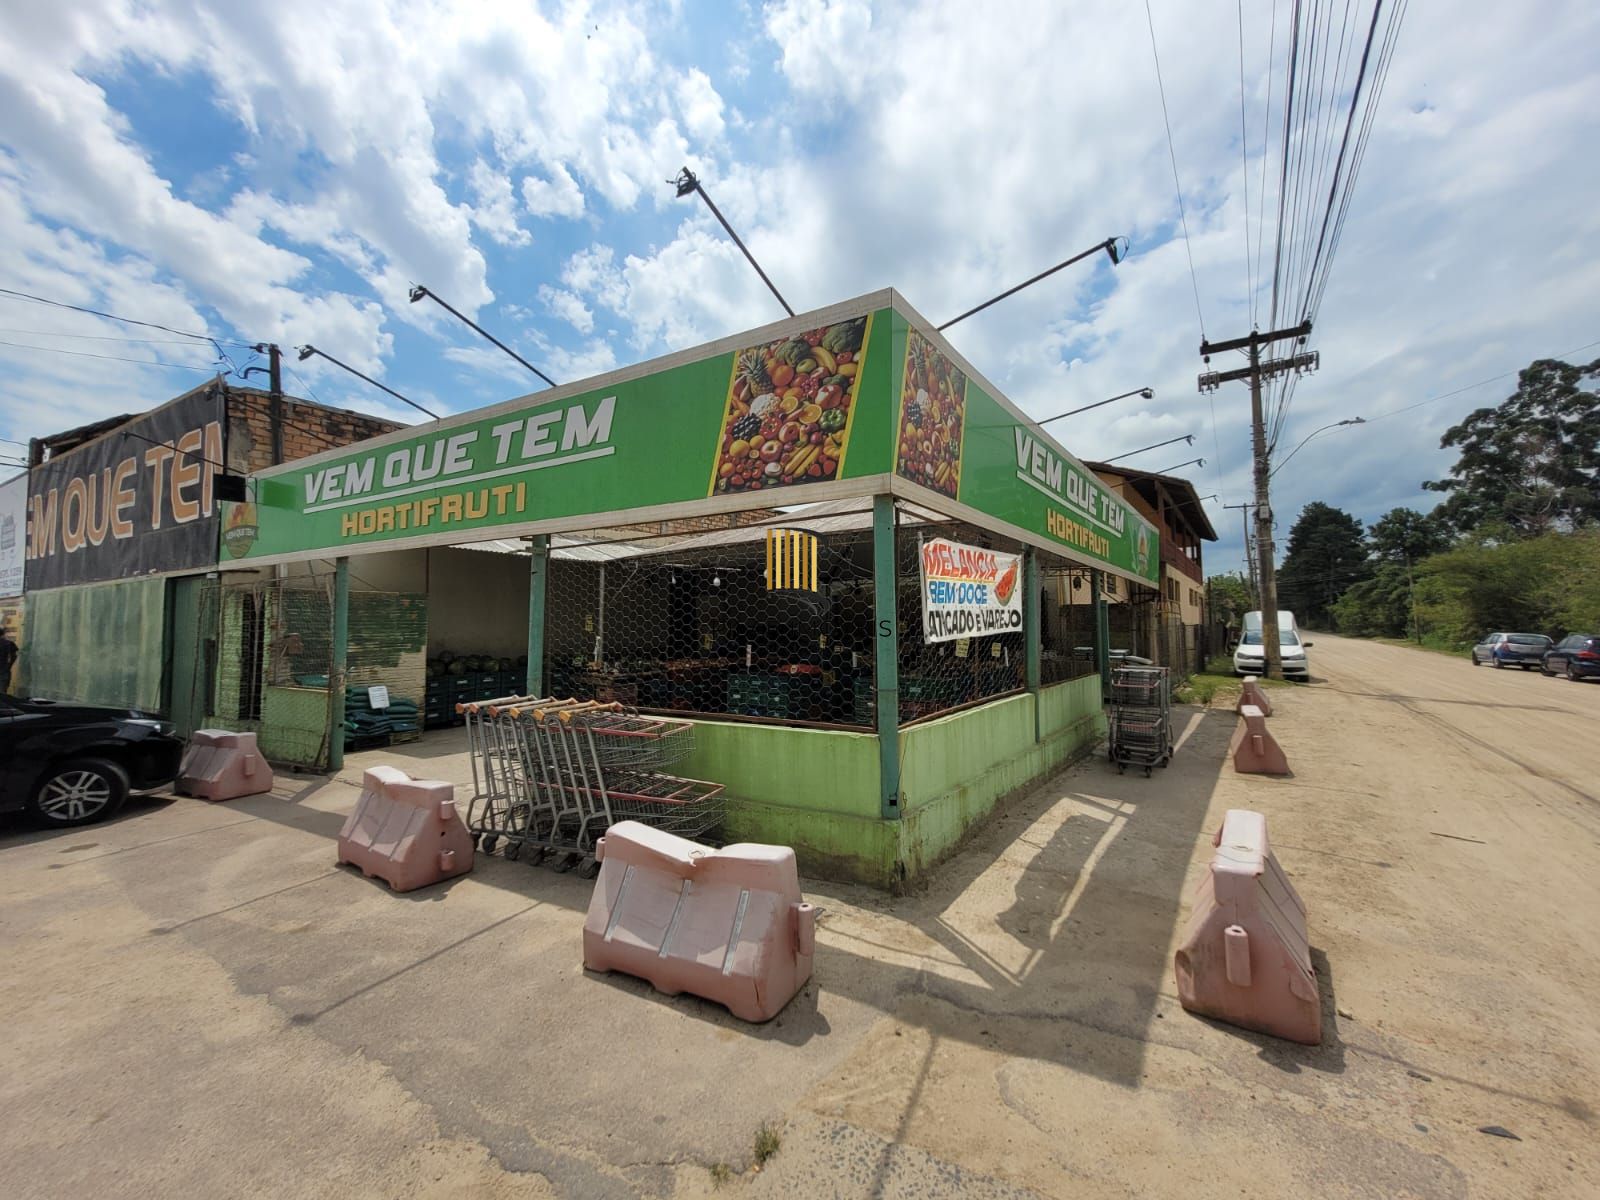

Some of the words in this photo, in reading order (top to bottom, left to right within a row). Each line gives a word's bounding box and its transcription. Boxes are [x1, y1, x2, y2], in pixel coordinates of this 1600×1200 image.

[304, 457, 376, 504] VEM
[382, 430, 478, 488] QUE
[492, 396, 616, 465] TEM
[62, 456, 137, 553] QUE
[1014, 425, 1062, 492] VEM
[1066, 469, 1098, 516] QUE
[1101, 494, 1125, 533] TEM
[341, 481, 526, 537] HORTIFRUTI
[1047, 507, 1109, 558] HORTIFRUTI
[923, 543, 998, 580] MELANCIA
[929, 581, 956, 604] BEM
[958, 582, 988, 604] DOCE
[975, 613, 981, 632] E
[980, 609, 1021, 631] VAREJO
